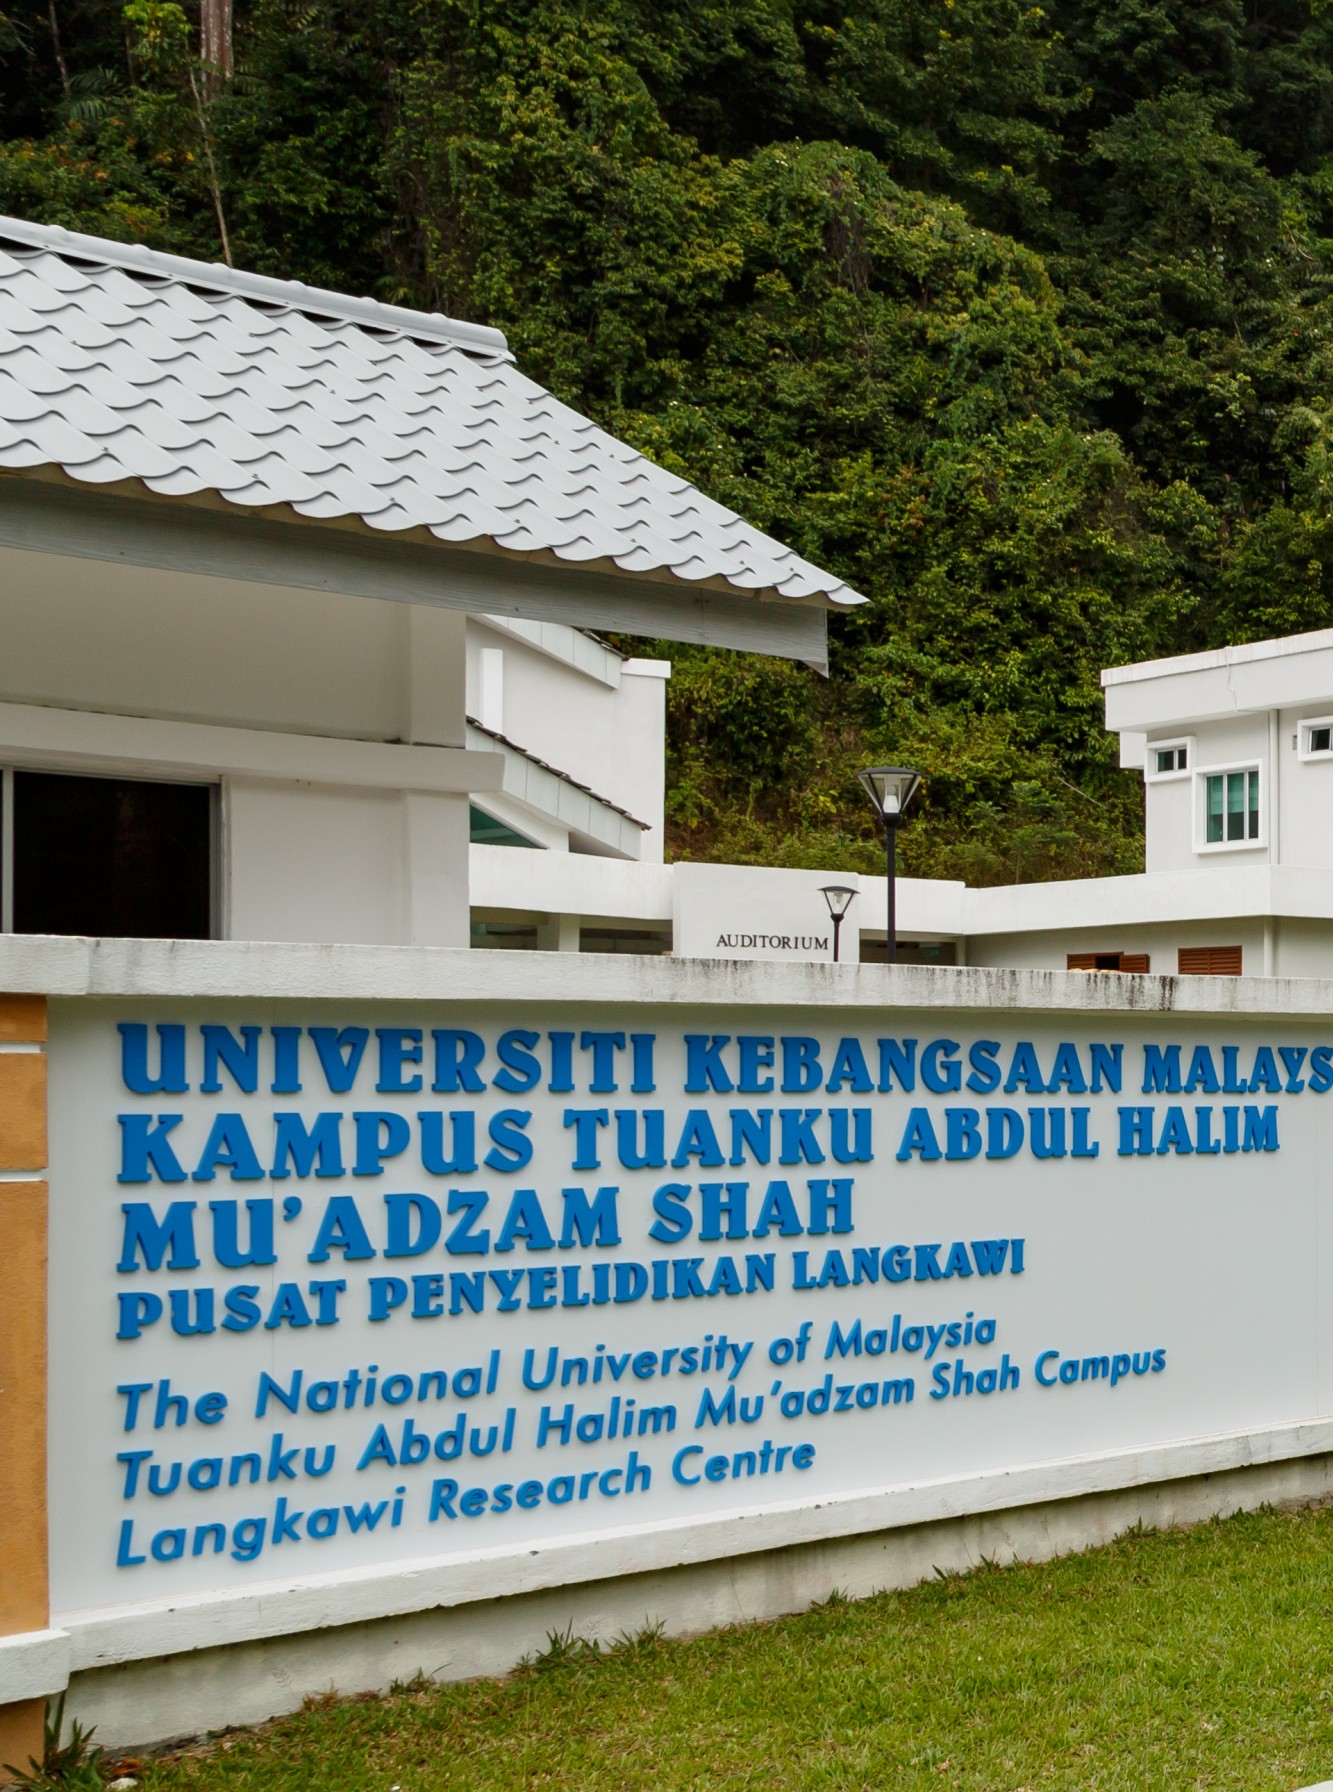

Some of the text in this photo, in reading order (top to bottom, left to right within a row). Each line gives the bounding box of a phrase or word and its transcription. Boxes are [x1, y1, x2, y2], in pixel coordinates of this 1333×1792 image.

[716, 934, 829, 950] AUDITORIUM
[117, 1022, 657, 1095] UNIVERSITI
[683, 1034, 1124, 1094] KEBANGSAAN
[116, 1105, 1281, 1183] KAMPUS TUANKU ABDUL HALIM
[116, 1178, 855, 1273] MU'ADZAM SHAH
[116, 1238, 1026, 1340] PUSAT PENYELIDIKAN LANGKAWI
[117, 1312, 997, 1432] The National University of Malaysia
[117, 1348, 1167, 1500] Tuanku Abdul Halim Mu'adzam Shah Campus
[116, 1440, 816, 1568] Langkawi Research Centre
